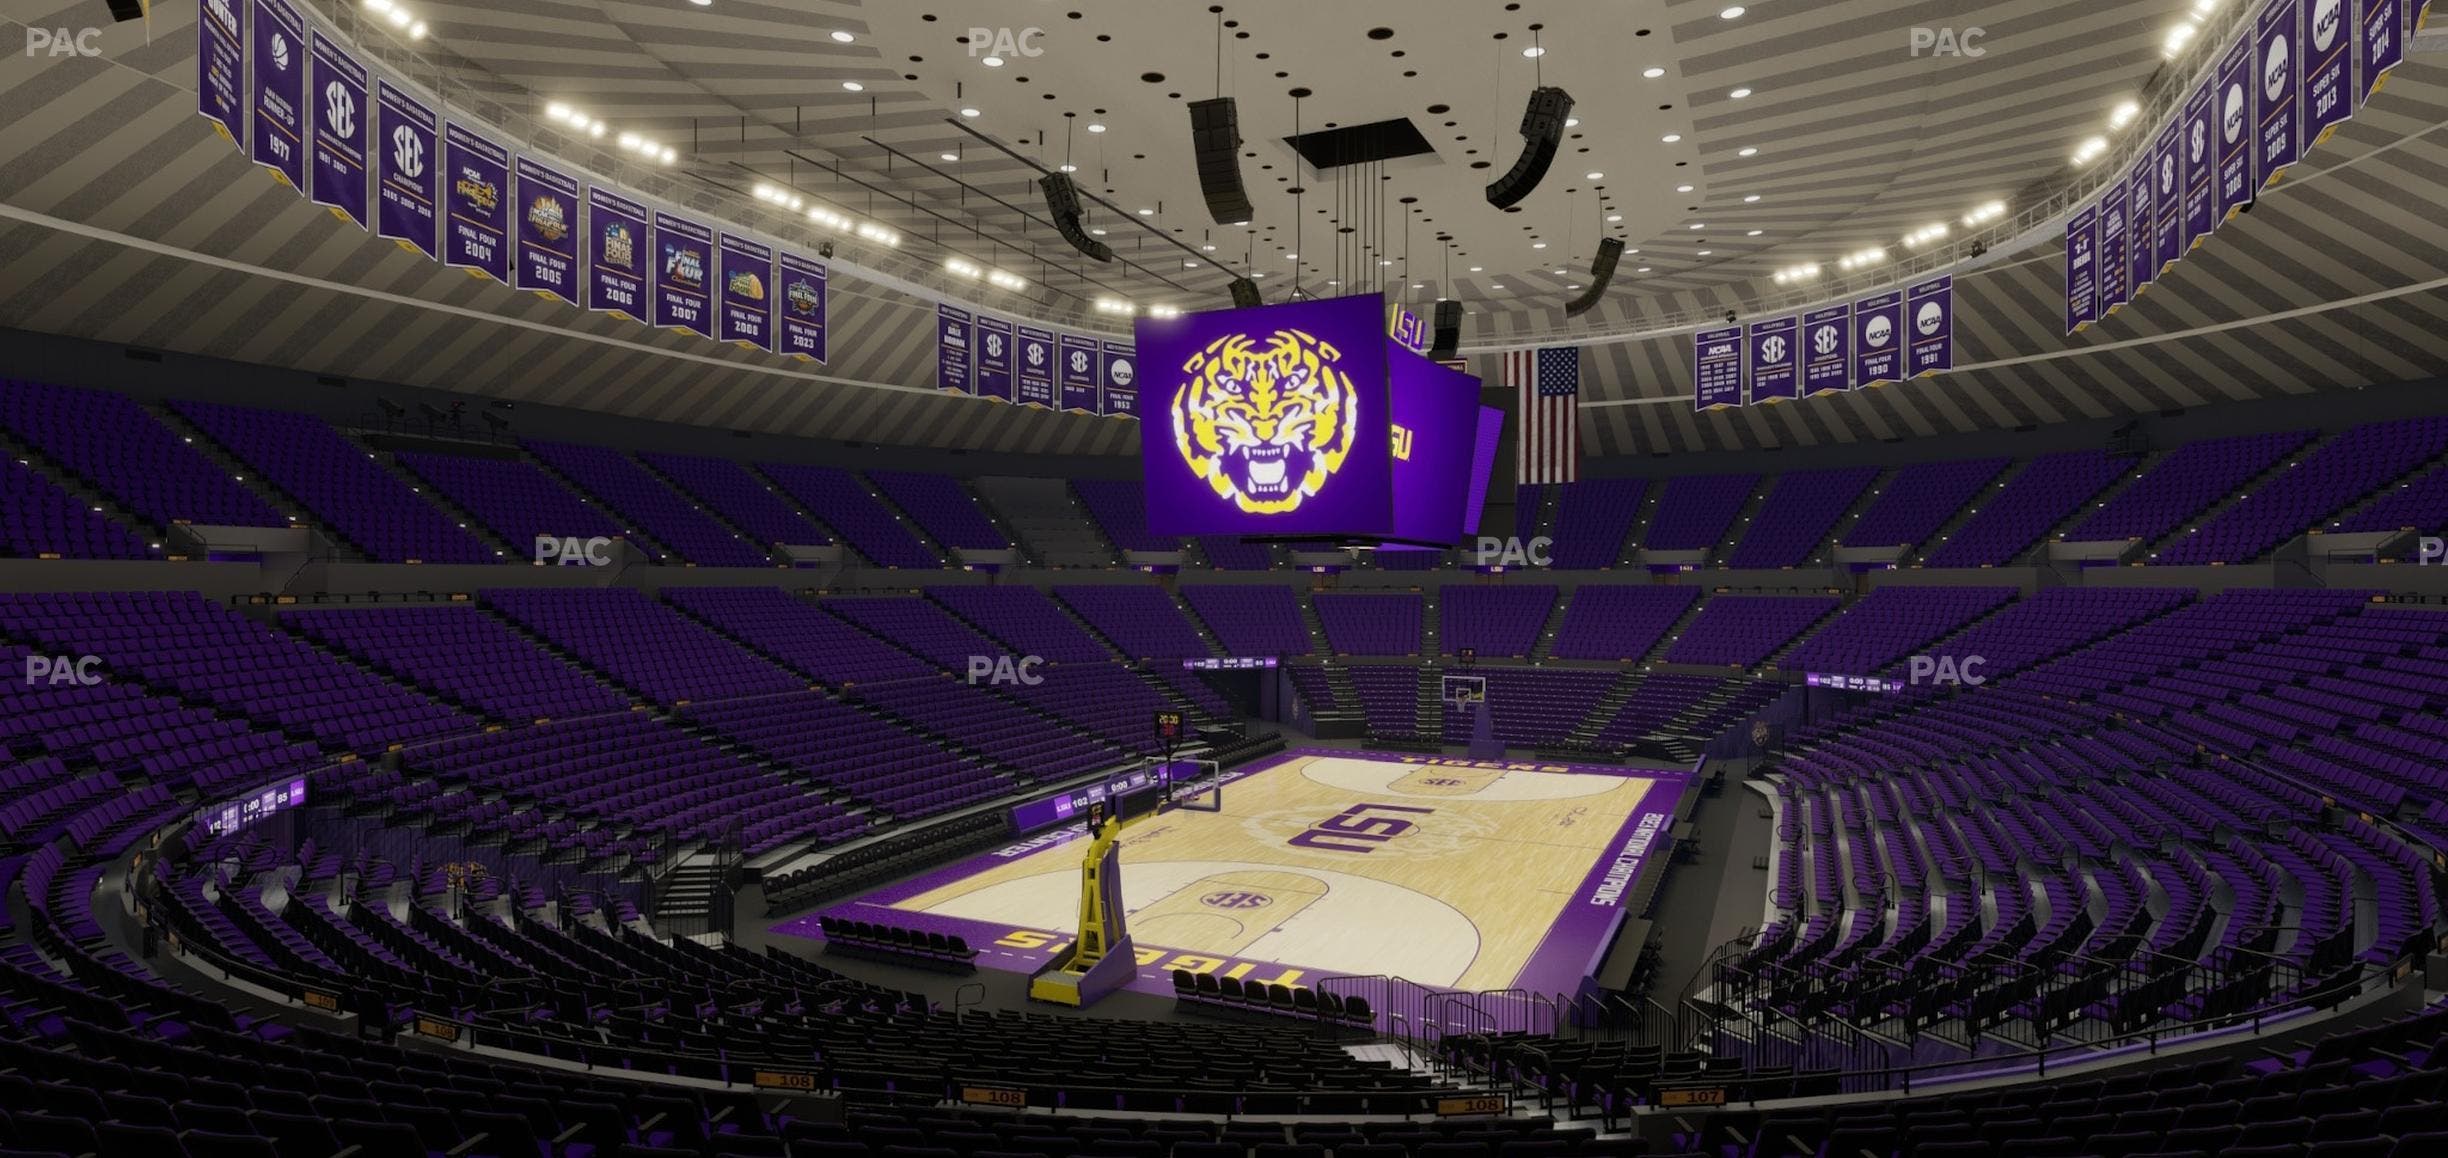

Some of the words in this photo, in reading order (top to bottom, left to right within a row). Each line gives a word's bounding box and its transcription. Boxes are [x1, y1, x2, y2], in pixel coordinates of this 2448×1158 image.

[2372, 27, 2389, 65] 2014
[2312, 74, 2329, 98] SUPER
[325, 81, 356, 139] SEC
[2316, 85, 2337, 119] 2013
[2265, 121, 2280, 143] SUPER
[270, 133, 290, 161] 1977
[393, 125, 424, 178] SEC
[2267, 132, 2287, 163] 2009
[458, 225, 477, 241] FINAL
[478, 232, 497, 248] FOUR
[465, 240, 493, 262] 2004
[529, 251, 548, 265] FINAL
[548, 257, 567, 272] FOUR
[535, 265, 562, 286] 2005
[601, 274, 619, 287] FINAL
[620, 280, 637, 292] FOUR
[606, 287, 633, 306] 2006
[666, 293, 684, 305] FINAL
[685, 298, 702, 310] FOUR
[671, 304, 698, 322] 2007
[730, 308, 747, 320] FINAL
[747, 313, 763, 324] FOUR
[734, 320, 759, 336] 2008
[1390, 303, 1426, 352] LSU
[1868, 328, 1892, 341] NCAA
[793, 333, 815, 349] 2023
[986, 333, 1003, 358] SEC
[1814, 325, 1839, 354] SEC
[1915, 346, 1929, 356] FINAL
[1928, 342, 1943, 352] FOUR
[1708, 344, 1732, 356] NCAA
[1761, 335, 1787, 364] SEC
[1921, 352, 1938, 366] 1991
[1864, 356, 1879, 367] FINAL
[1878, 354, 1892, 364] FOUR
[1868, 363, 1889, 376] 1990
[1849, 677, 1864, 685] 0:00
[277, 792, 288, 804] 85
[1072, 796, 1089, 809] 102
[1110, 779, 1128, 793] 0:00
[1287, 803, 1437, 854] LSU
[1589, 857, 1641, 907] CHAMPIONS
[1205, 892, 1271, 909] SEC
[780, 1075, 811, 1088] 108
[988, 1090, 1021, 1104] 108
[1464, 1099, 1499, 1112] 108
[1687, 1091, 1720, 1104] 107
